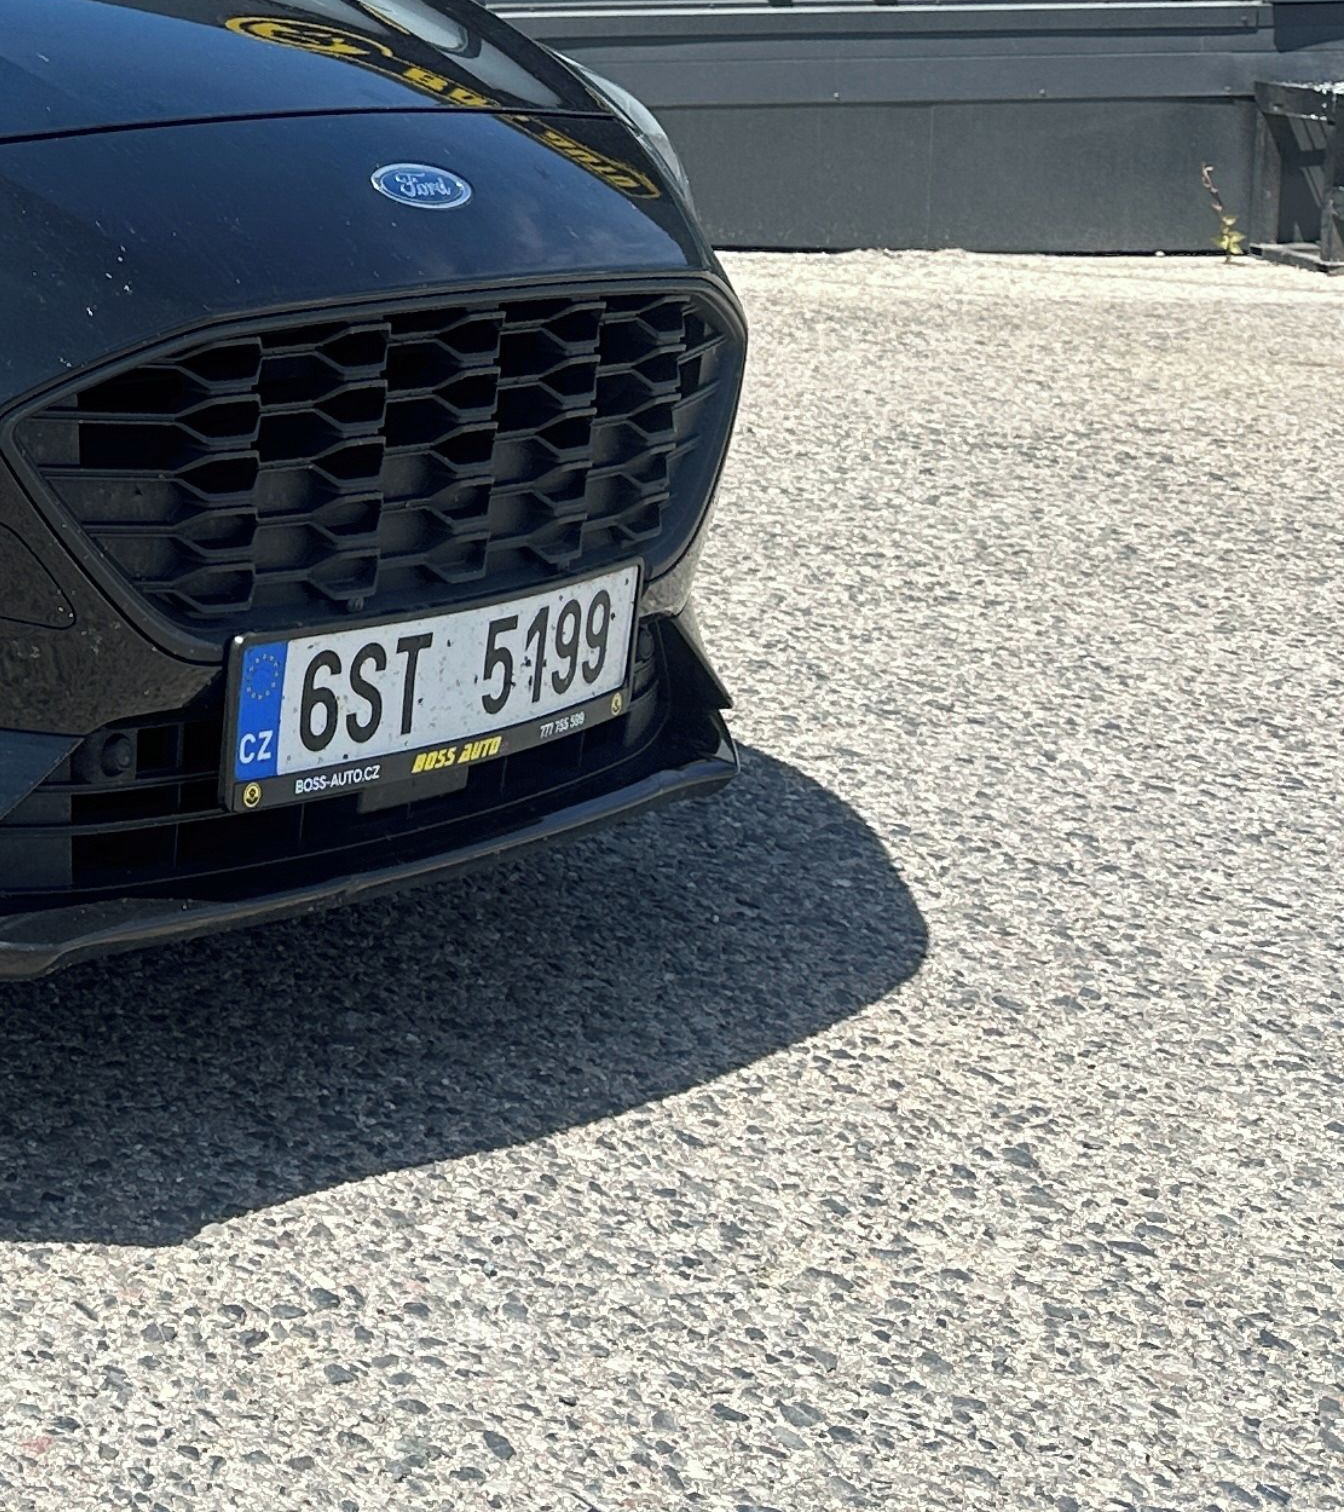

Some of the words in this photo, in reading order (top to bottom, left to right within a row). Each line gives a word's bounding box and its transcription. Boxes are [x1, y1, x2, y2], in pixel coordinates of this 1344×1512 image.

[299, 632, 434, 752] 6ST
[482, 589, 611, 715] 5199
[239, 730, 273, 764] CZ
[411, 747, 455, 774] BOSS
[457, 736, 502, 763] AUTO
[295, 765, 381, 794] BOSS-AUTO.CZ
